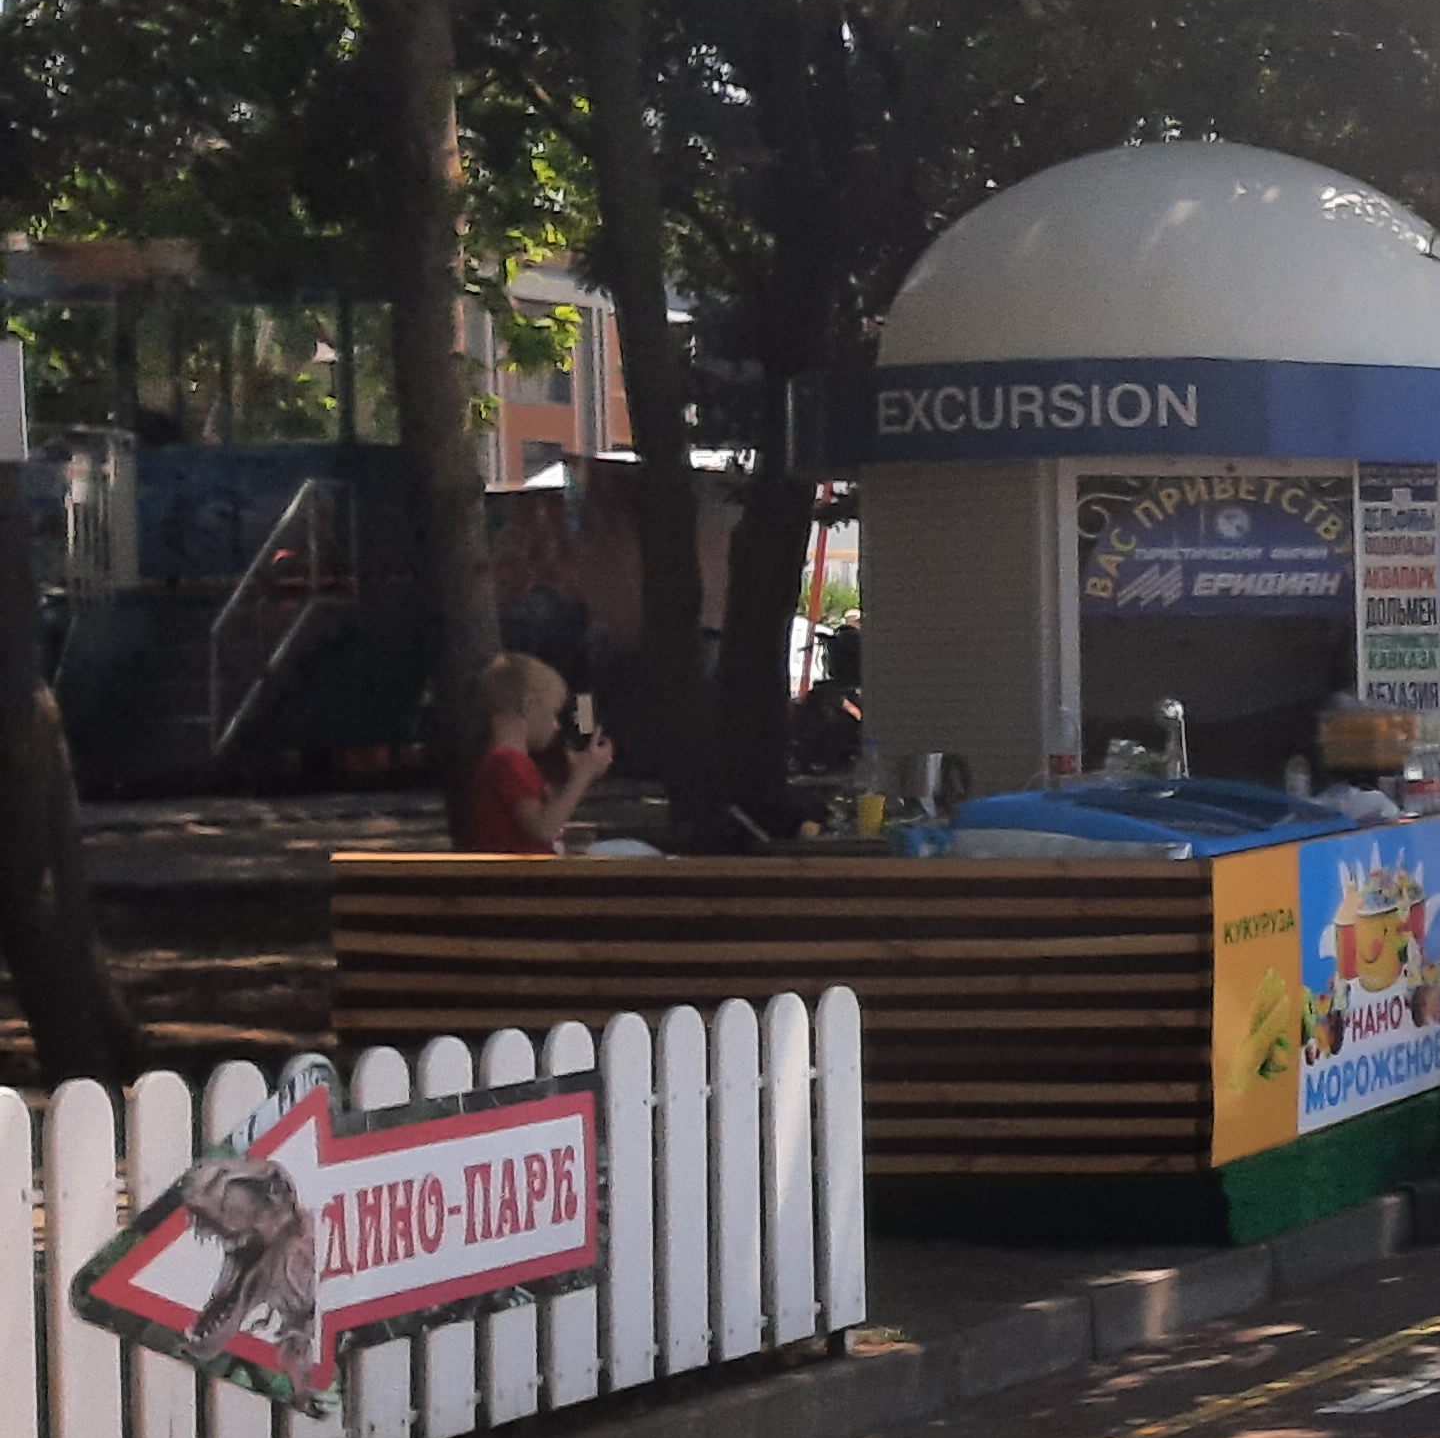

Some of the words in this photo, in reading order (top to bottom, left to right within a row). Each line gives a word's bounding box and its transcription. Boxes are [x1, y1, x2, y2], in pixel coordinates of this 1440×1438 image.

[877, 382, 1199, 435] EXCURSION
[1085, 527, 1138, 598] ВАС
[1133, 476, 1353, 557] ПРИВЕТСТВ
[1366, 596, 1438, 629] ДОЛЬМЕН
[1223, 908, 1295, 945] КУКУРУЗА
[320, 1145, 578, 1283] ДИНО-ПАРК
